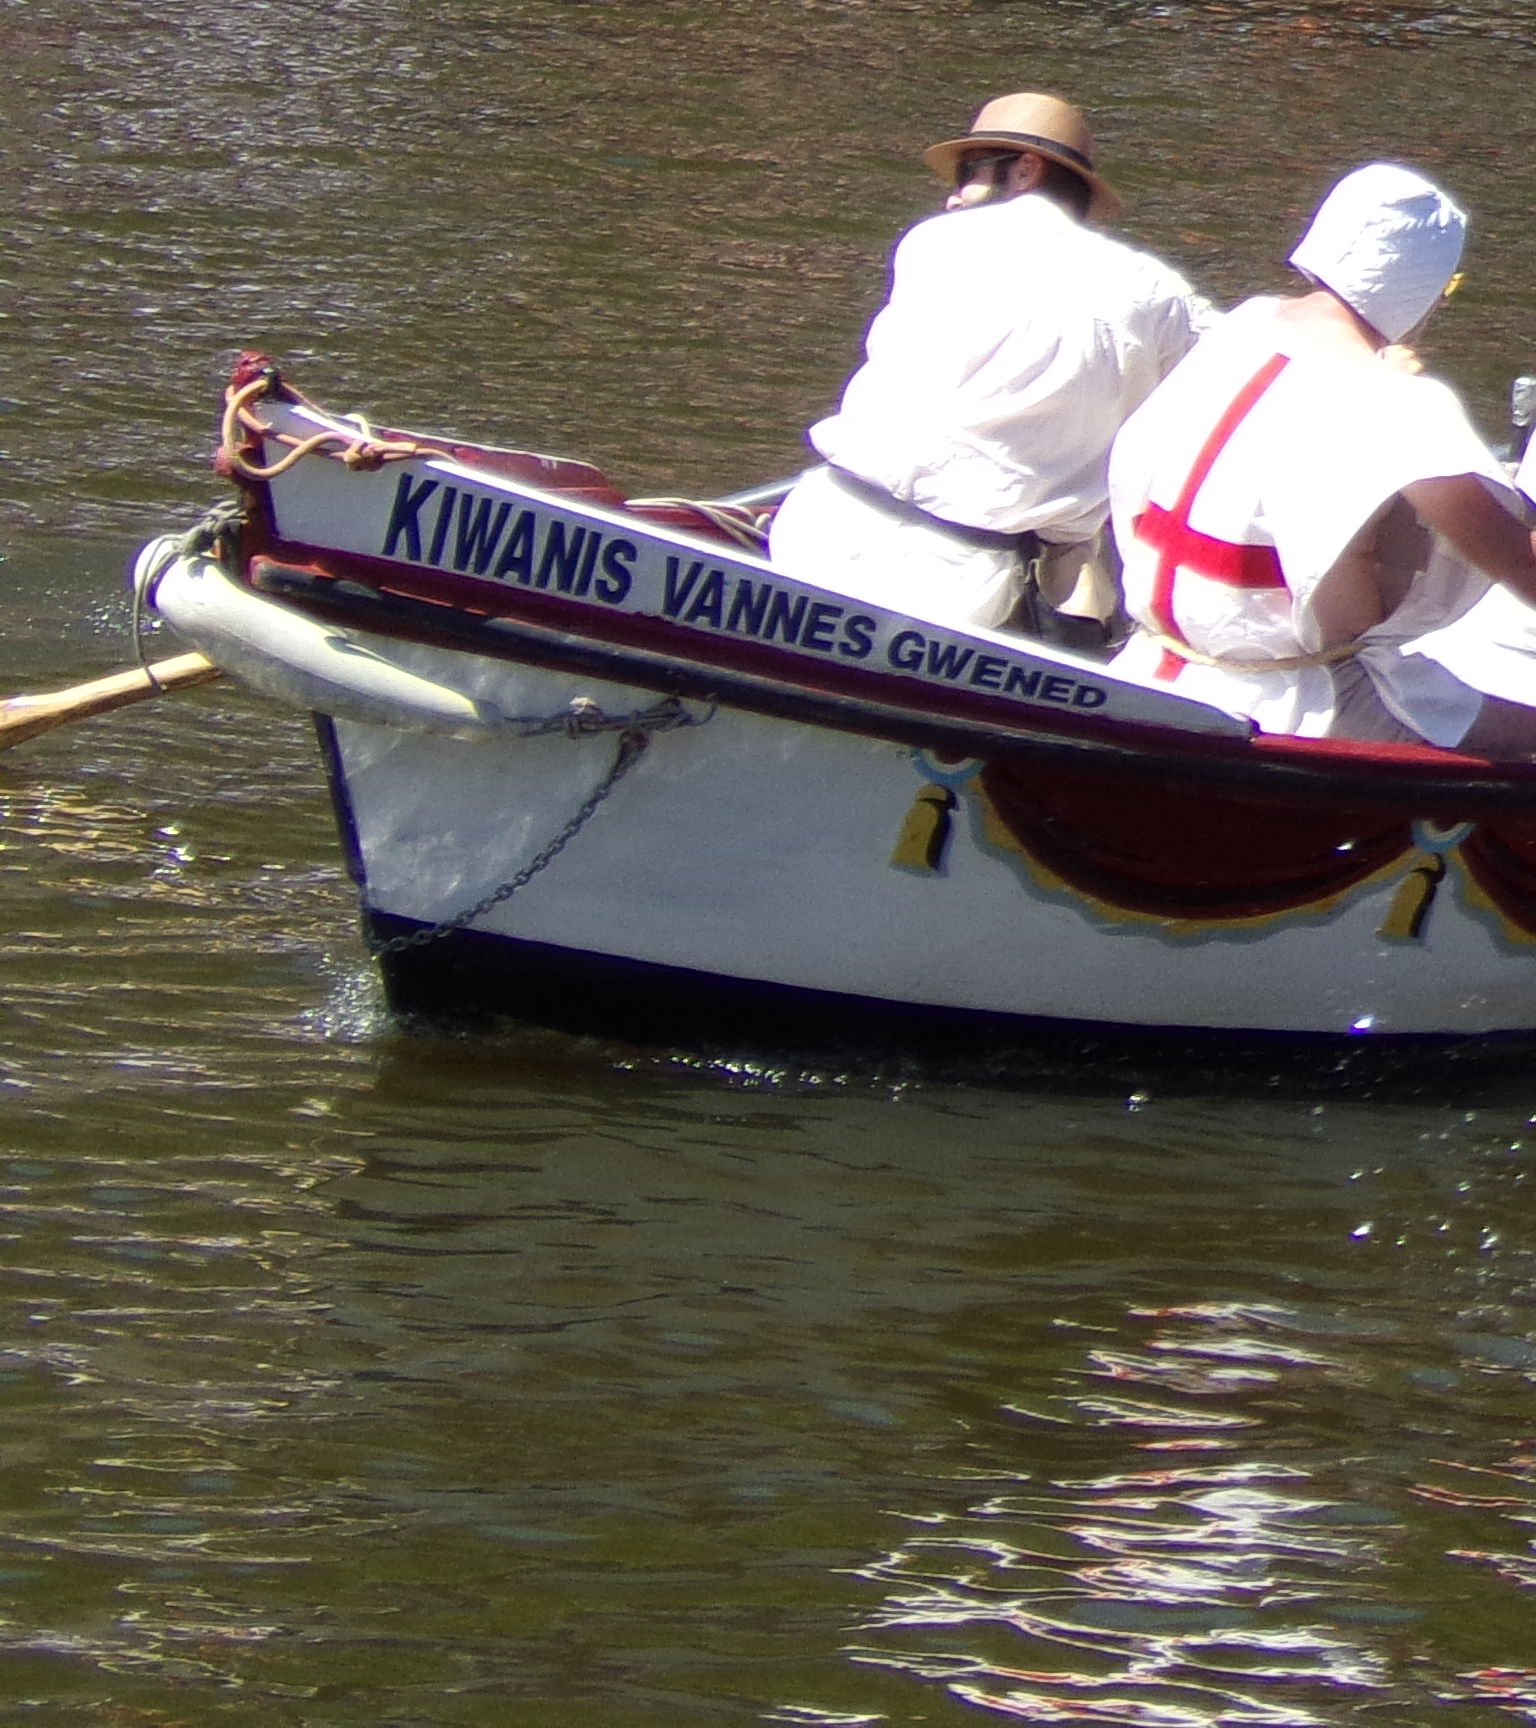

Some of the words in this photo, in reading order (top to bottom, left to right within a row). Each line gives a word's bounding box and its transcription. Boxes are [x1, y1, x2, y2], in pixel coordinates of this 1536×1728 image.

[383, 472, 638, 604] KIWANIS
[664, 555, 876, 662] VANNES
[887, 629, 1107, 710] GWENED
